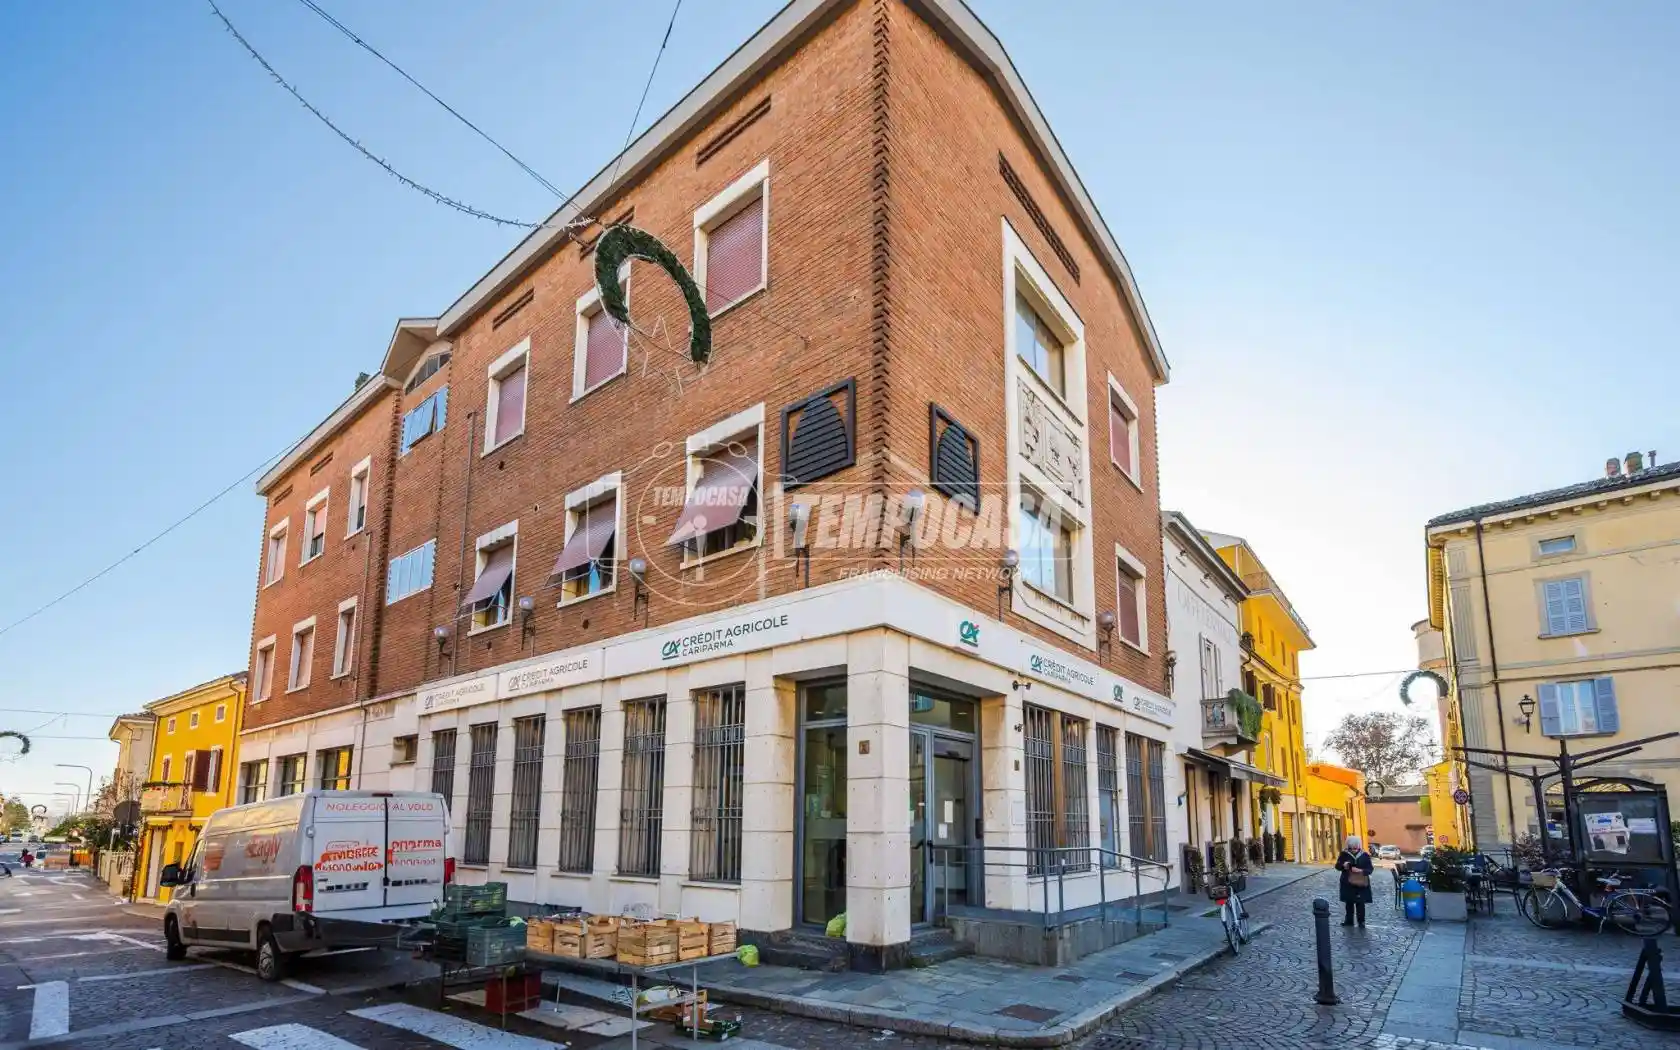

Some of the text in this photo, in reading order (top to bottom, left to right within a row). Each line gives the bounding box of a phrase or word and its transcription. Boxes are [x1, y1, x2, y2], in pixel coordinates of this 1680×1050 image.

[725, 615, 788, 638] AGRICOLE
[682, 639, 734, 657] CARIPARMA
[392, 802, 405, 811] AL
[408, 802, 433, 811] VOLO
